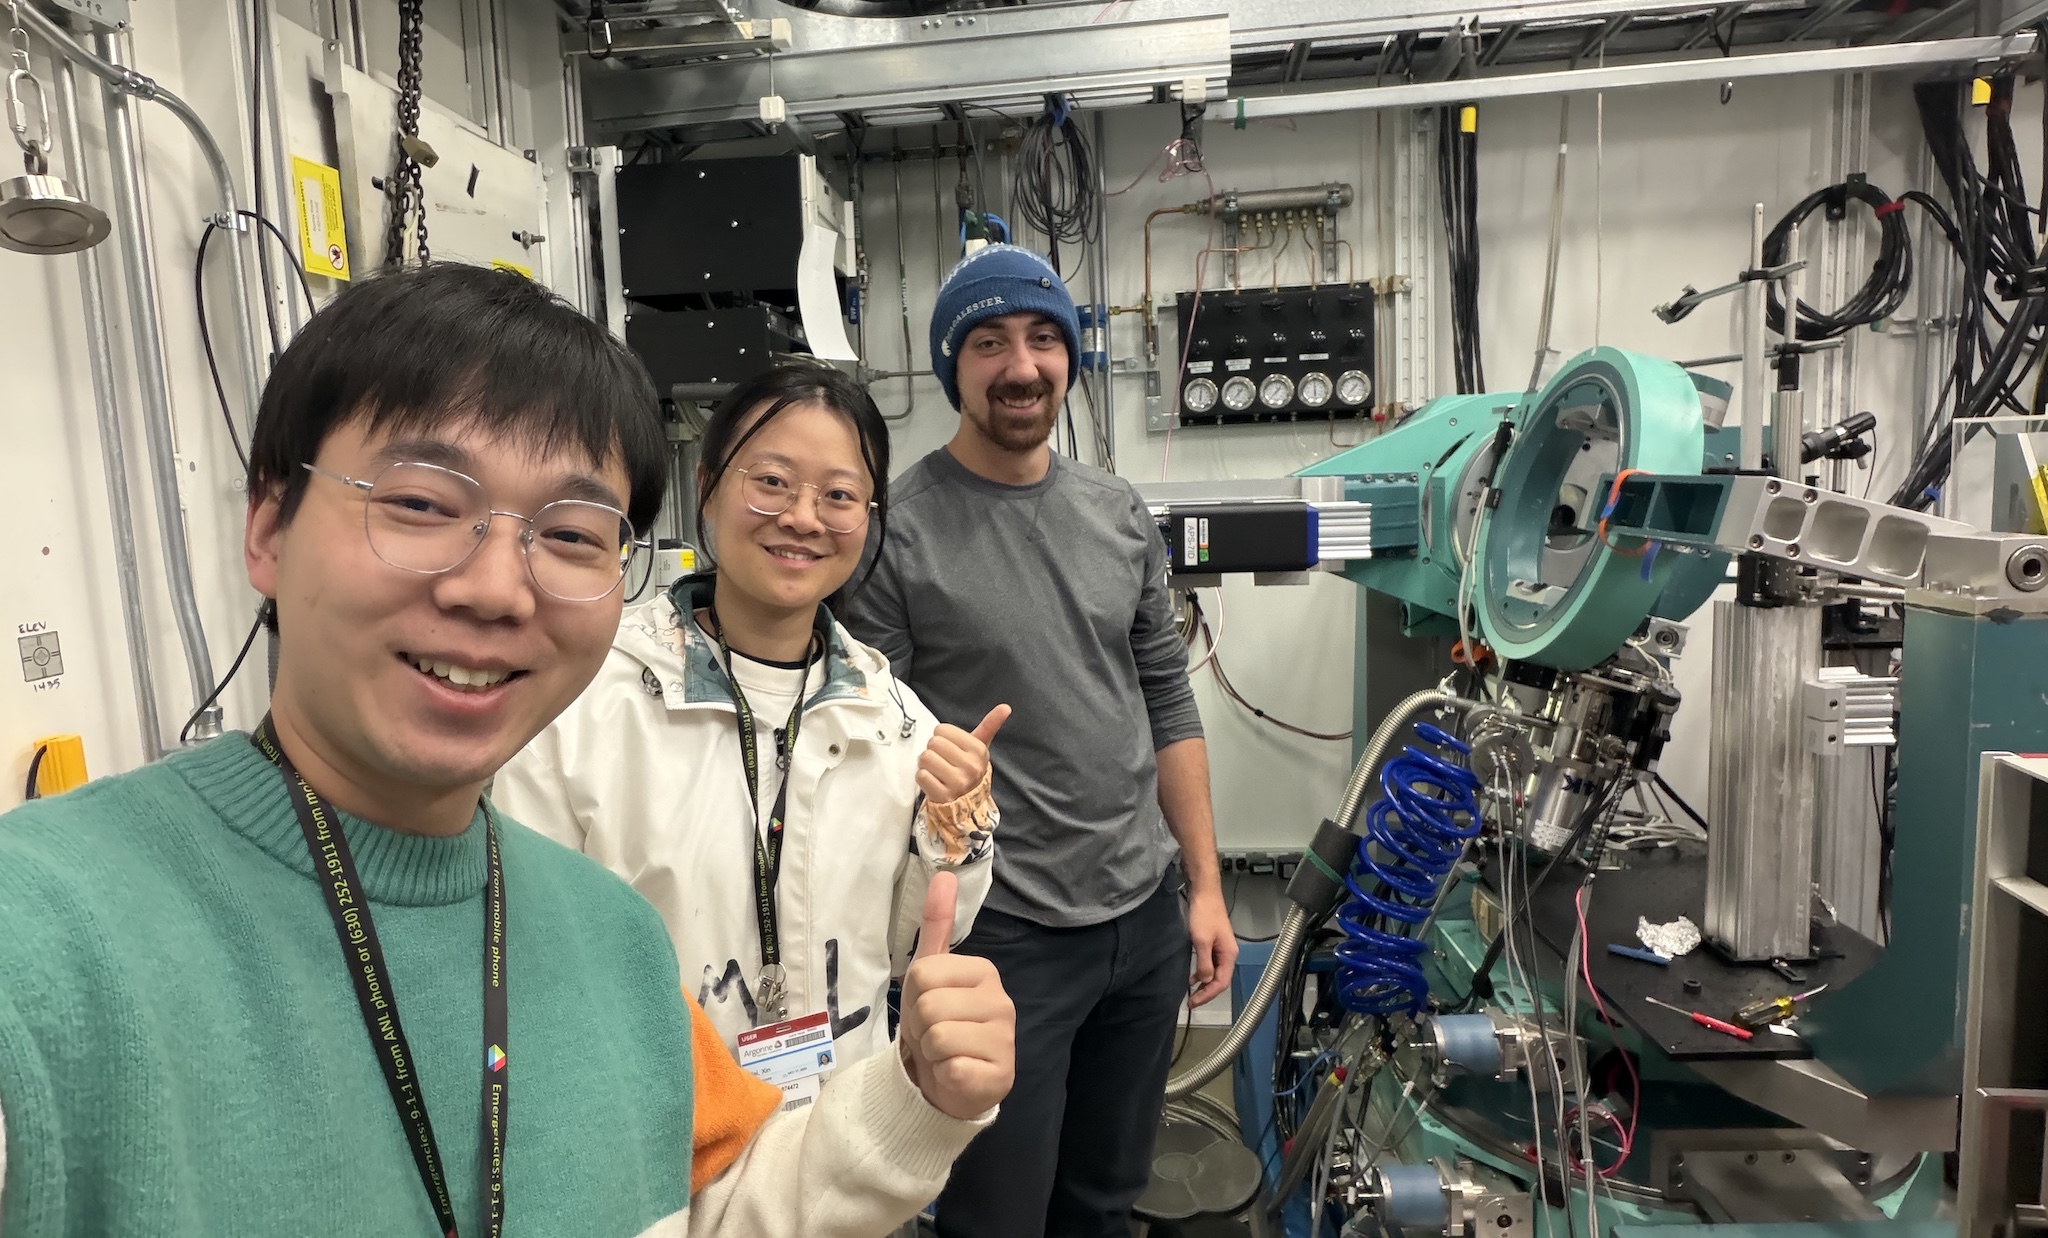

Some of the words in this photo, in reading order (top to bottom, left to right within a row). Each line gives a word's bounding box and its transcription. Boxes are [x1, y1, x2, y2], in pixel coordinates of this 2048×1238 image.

[1187, 524, 1196, 559] APS-7ID
[742, 714, 753, 748] 252-1911
[747, 749, 755, 769] (630)
[311, 807, 331, 840] from
[322, 842, 353, 907] 252-1911
[757, 850, 766, 877] mobile
[342, 907, 368, 944] (630)
[493, 900, 502, 943] mobile
[763, 898, 774, 933] 252-1911
[357, 947, 371, 962] or
[491, 946, 501, 987] phone
[363, 964, 388, 1009] phone
[825, 938, 871, 1040] L
[377, 1011, 397, 1041] ANL
[741, 1033, 757, 1042] USER
[390, 1045, 408, 1080] from
[744, 1044, 773, 1058] Argonne
[401, 1081, 422, 1120] 9-1-1
[491, 1084, 502, 1178] Emergencies:
[417, 1122, 450, 1215] Emergencies:
[491, 1183, 501, 1219] 9-1-1
